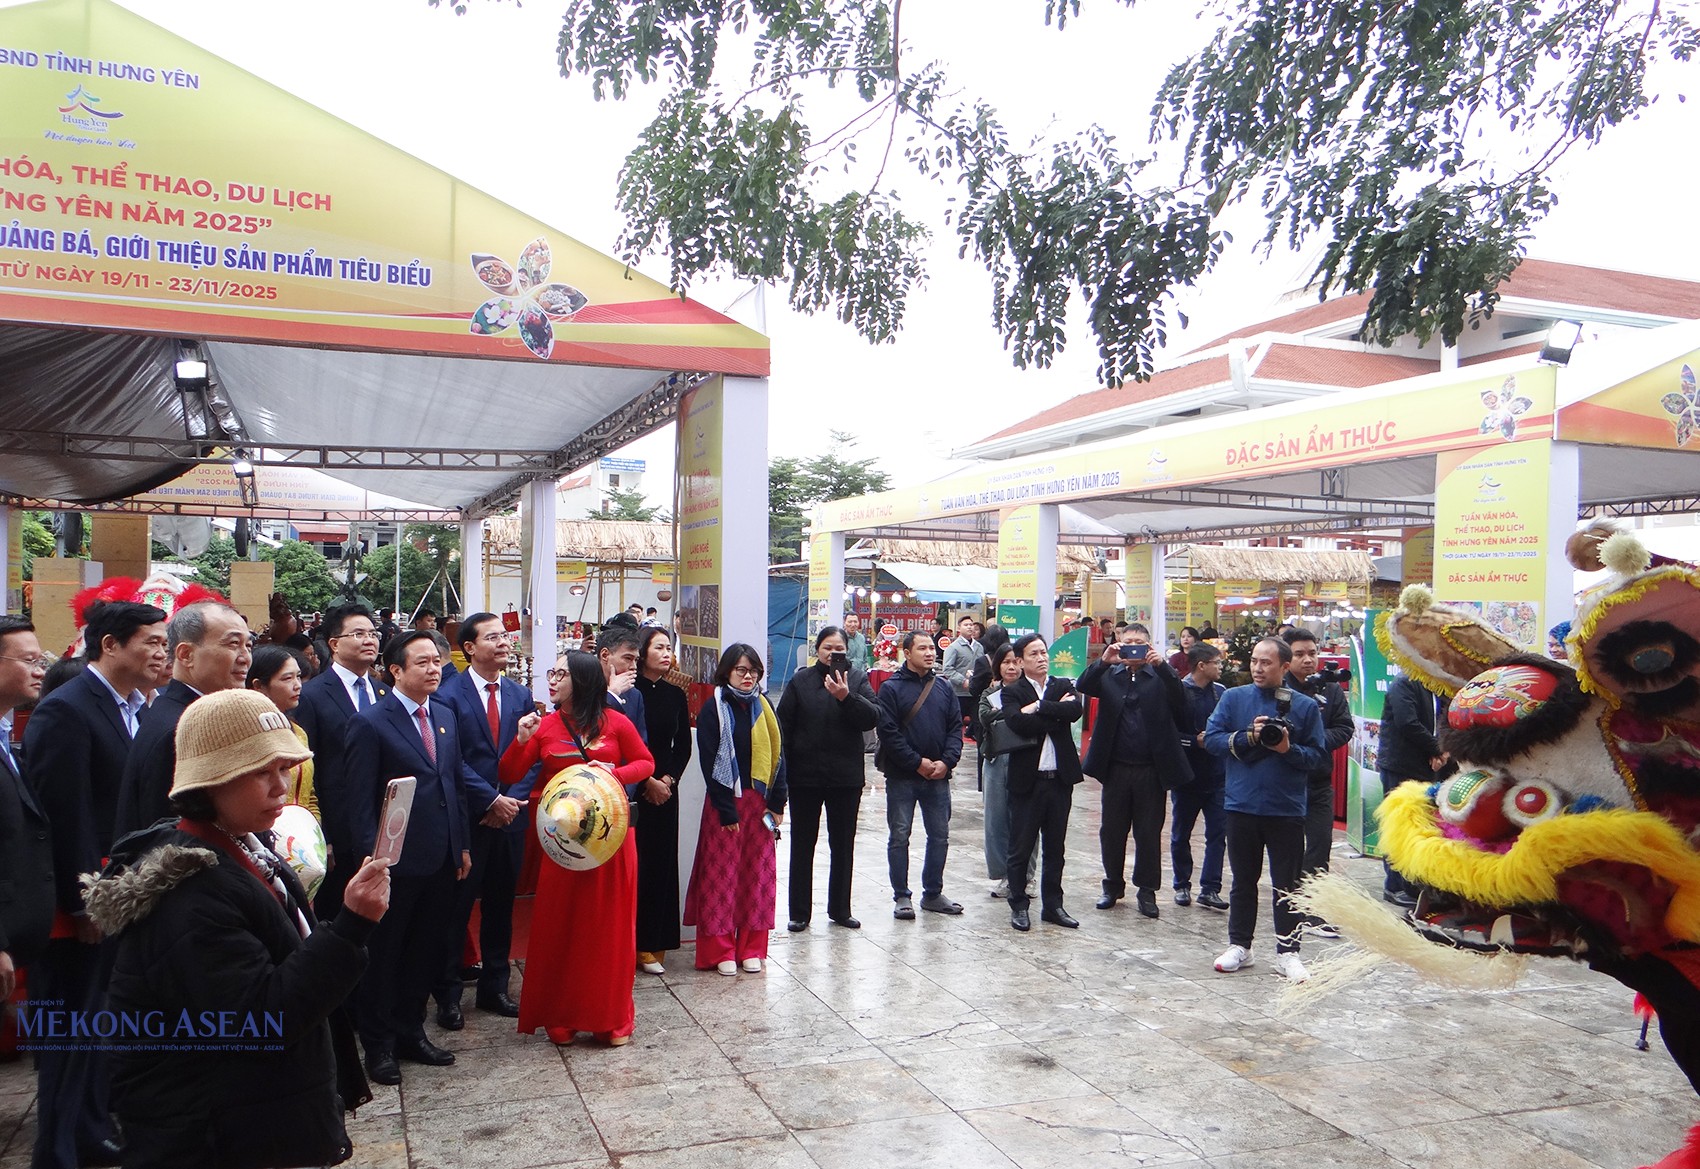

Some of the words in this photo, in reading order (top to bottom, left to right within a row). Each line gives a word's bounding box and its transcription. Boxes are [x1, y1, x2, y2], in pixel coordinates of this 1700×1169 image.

[45, 51, 92, 75] TỈNH
[98, 61, 156, 83] HƯNG
[161, 69, 200, 90] YÊN
[72, 161, 128, 189] THỂ
[135, 172, 220, 202] THAO,
[228, 183, 265, 204] DU
[273, 188, 332, 212] LỊCH
[0, 187, 46, 213] NG
[55, 194, 113, 219] YÊN
[122, 201, 185, 227] NĂM
[62, 229, 98, 257] BÁ,
[106, 233, 150, 260] GIỚI
[156, 241, 217, 269] THIỆU
[223, 243, 266, 271] SẢN
[273, 248, 333, 277] PHẨM
[339, 257, 381, 282] TIÊU
[387, 259, 432, 287] BIỂU
[0, 260, 30, 278] TỪ
[36, 264, 95, 284] NGÀY
[101, 271, 149, 289] 19/11
[168, 277, 277, 300] 23/11/2025
[1225, 442, 1259, 468] ĐẶC
[1264, 433, 1300, 460] SẢN
[1305, 424, 1334, 454] ẨM
[1340, 420, 1396, 450] THỰC
[1047, 479, 1064, 494] HƯNG
[1067, 475, 1080, 491] YÊN
[1082, 472, 1099, 489] NĂM
[1101, 471, 1120, 487] 2025
[1470, 526, 1492, 534] THAO,
[1483, 510, 1498, 520] VĂN
[1460, 538, 1480, 546] HƯNG
[1483, 536, 1498, 545] YÊN
[1499, 535, 1517, 544] NĂM
[1519, 536, 1538, 544] 2025
[1448, 574, 1466, 584] ĐẶC
[1468, 572, 1485, 582] SẢN
[1487, 570, 1500, 582] ẨM
[1503, 573, 1528, 584] THỰC
[908, 614, 931, 631] BIỂN
